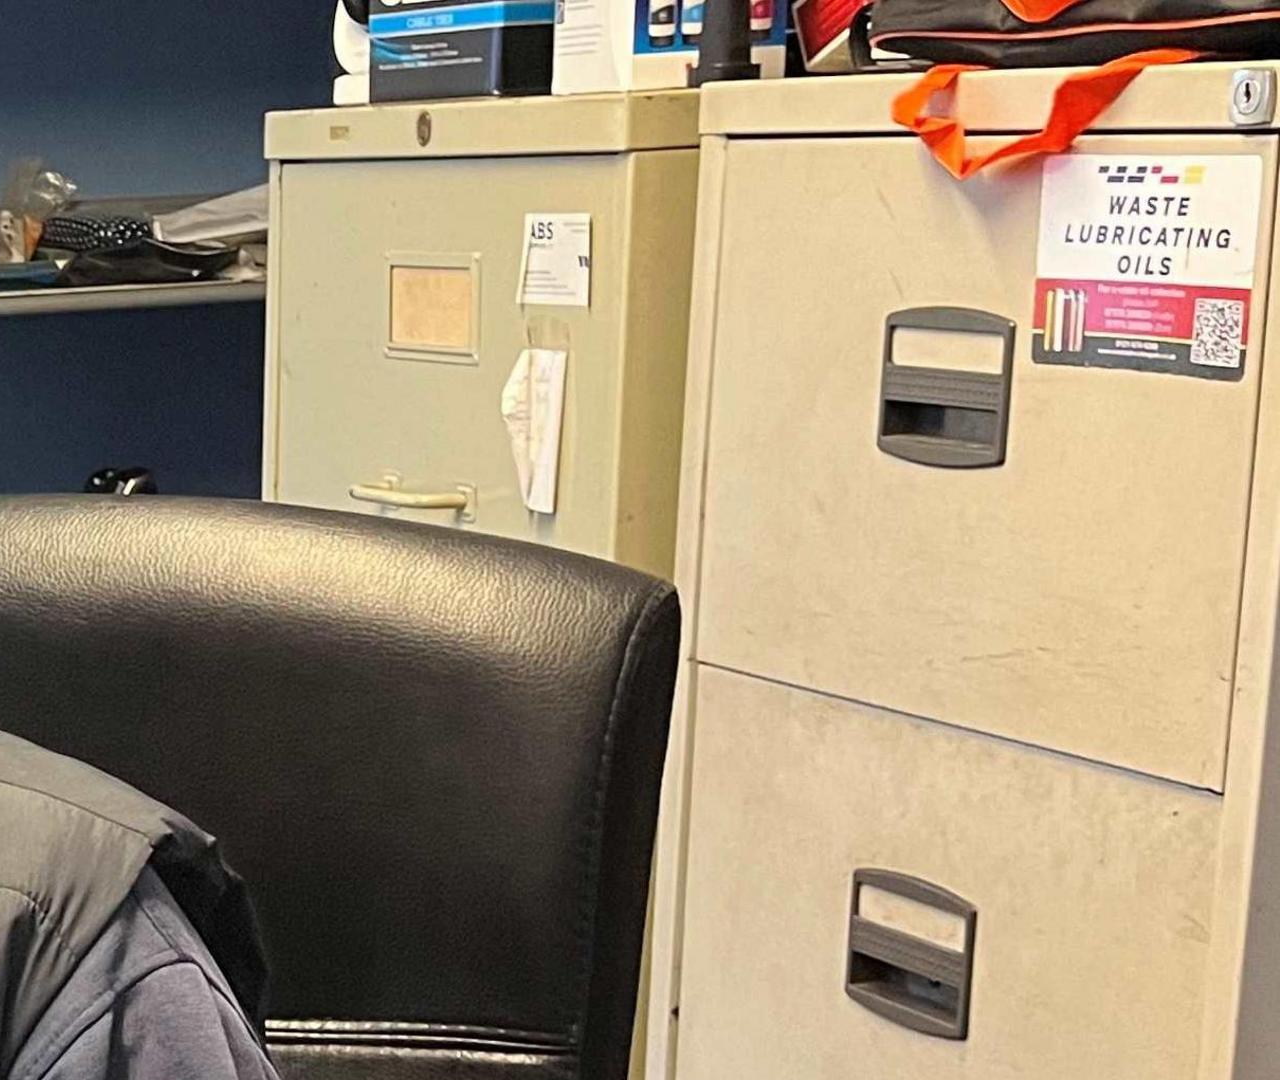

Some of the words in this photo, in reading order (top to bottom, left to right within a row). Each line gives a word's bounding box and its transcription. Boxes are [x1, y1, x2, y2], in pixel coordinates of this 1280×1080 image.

[1109, 195, 1191, 216] WASTE
[1064, 224, 1232, 249] LUBRICATING
[1117, 255, 1173, 276] OILS
